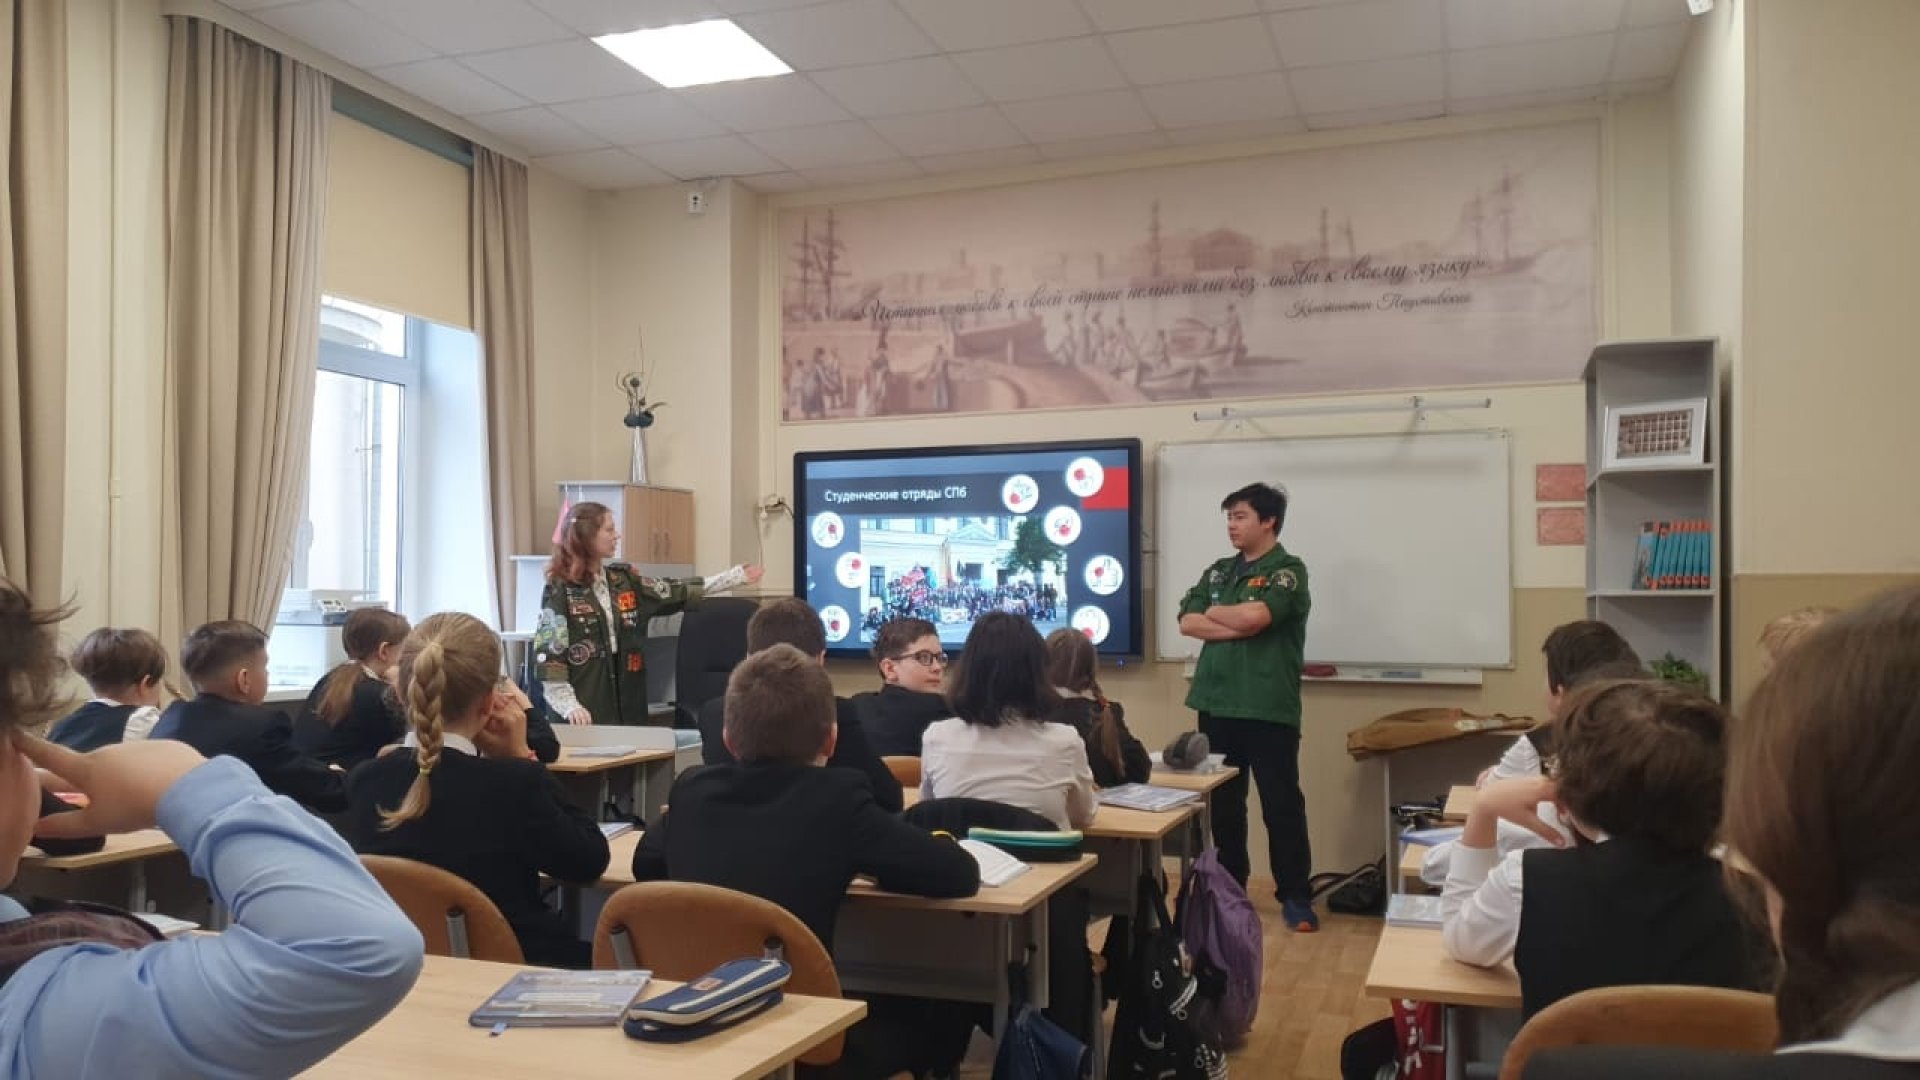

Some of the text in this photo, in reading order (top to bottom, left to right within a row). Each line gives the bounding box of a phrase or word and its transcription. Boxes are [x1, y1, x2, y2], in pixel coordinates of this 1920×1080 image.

[824, 486, 967, 504] Студенческие отряды СПб
